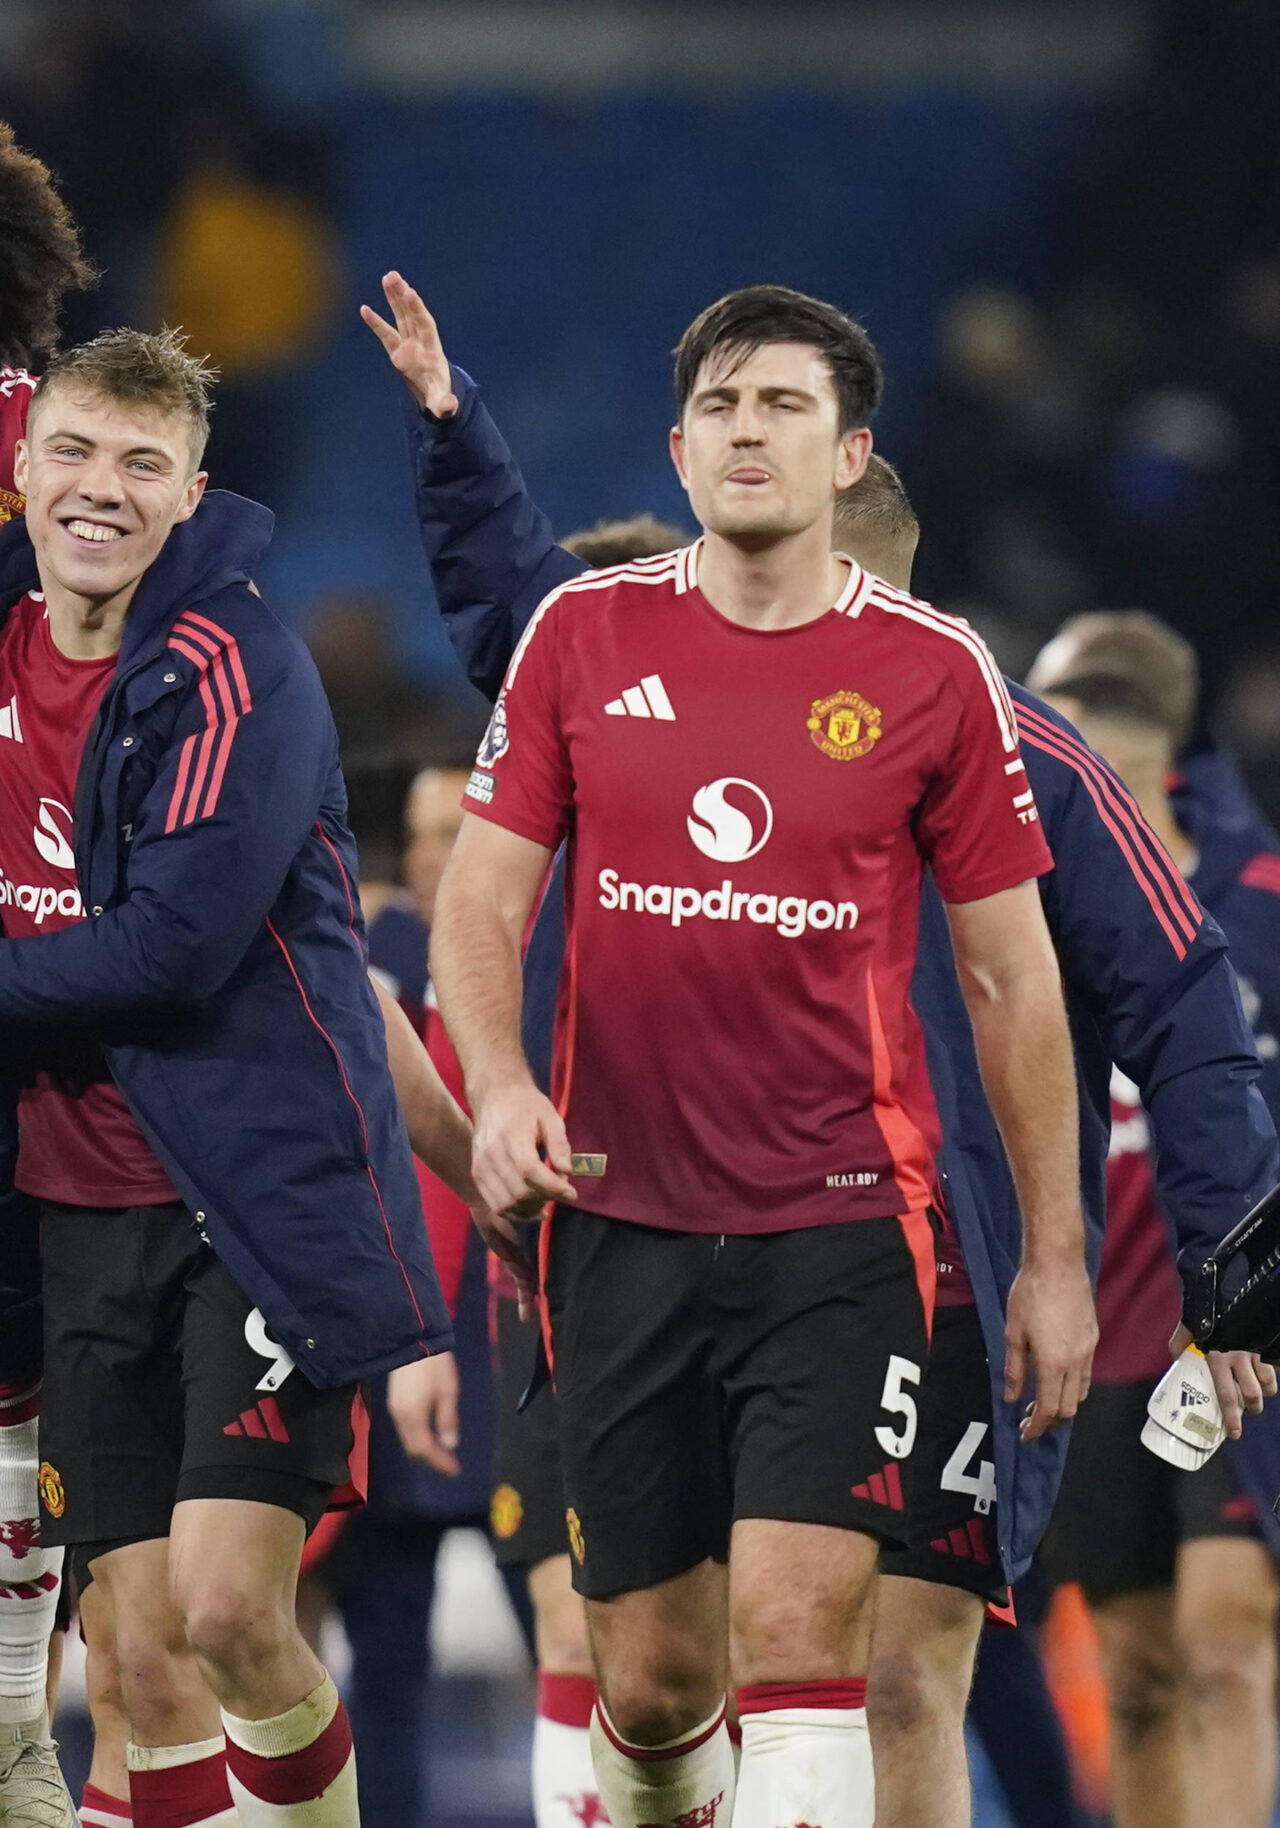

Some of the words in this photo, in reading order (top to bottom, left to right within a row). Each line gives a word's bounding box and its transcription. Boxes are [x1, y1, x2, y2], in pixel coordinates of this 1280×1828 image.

[822, 740, 864, 756] UNITED
[598, 868, 859, 938] Snapdragon
[244, 1307, 297, 1392] 9
[873, 1354, 921, 1459] 5
[1181, 1381, 1211, 1404] adidas
[940, 1421, 998, 1516] 4
